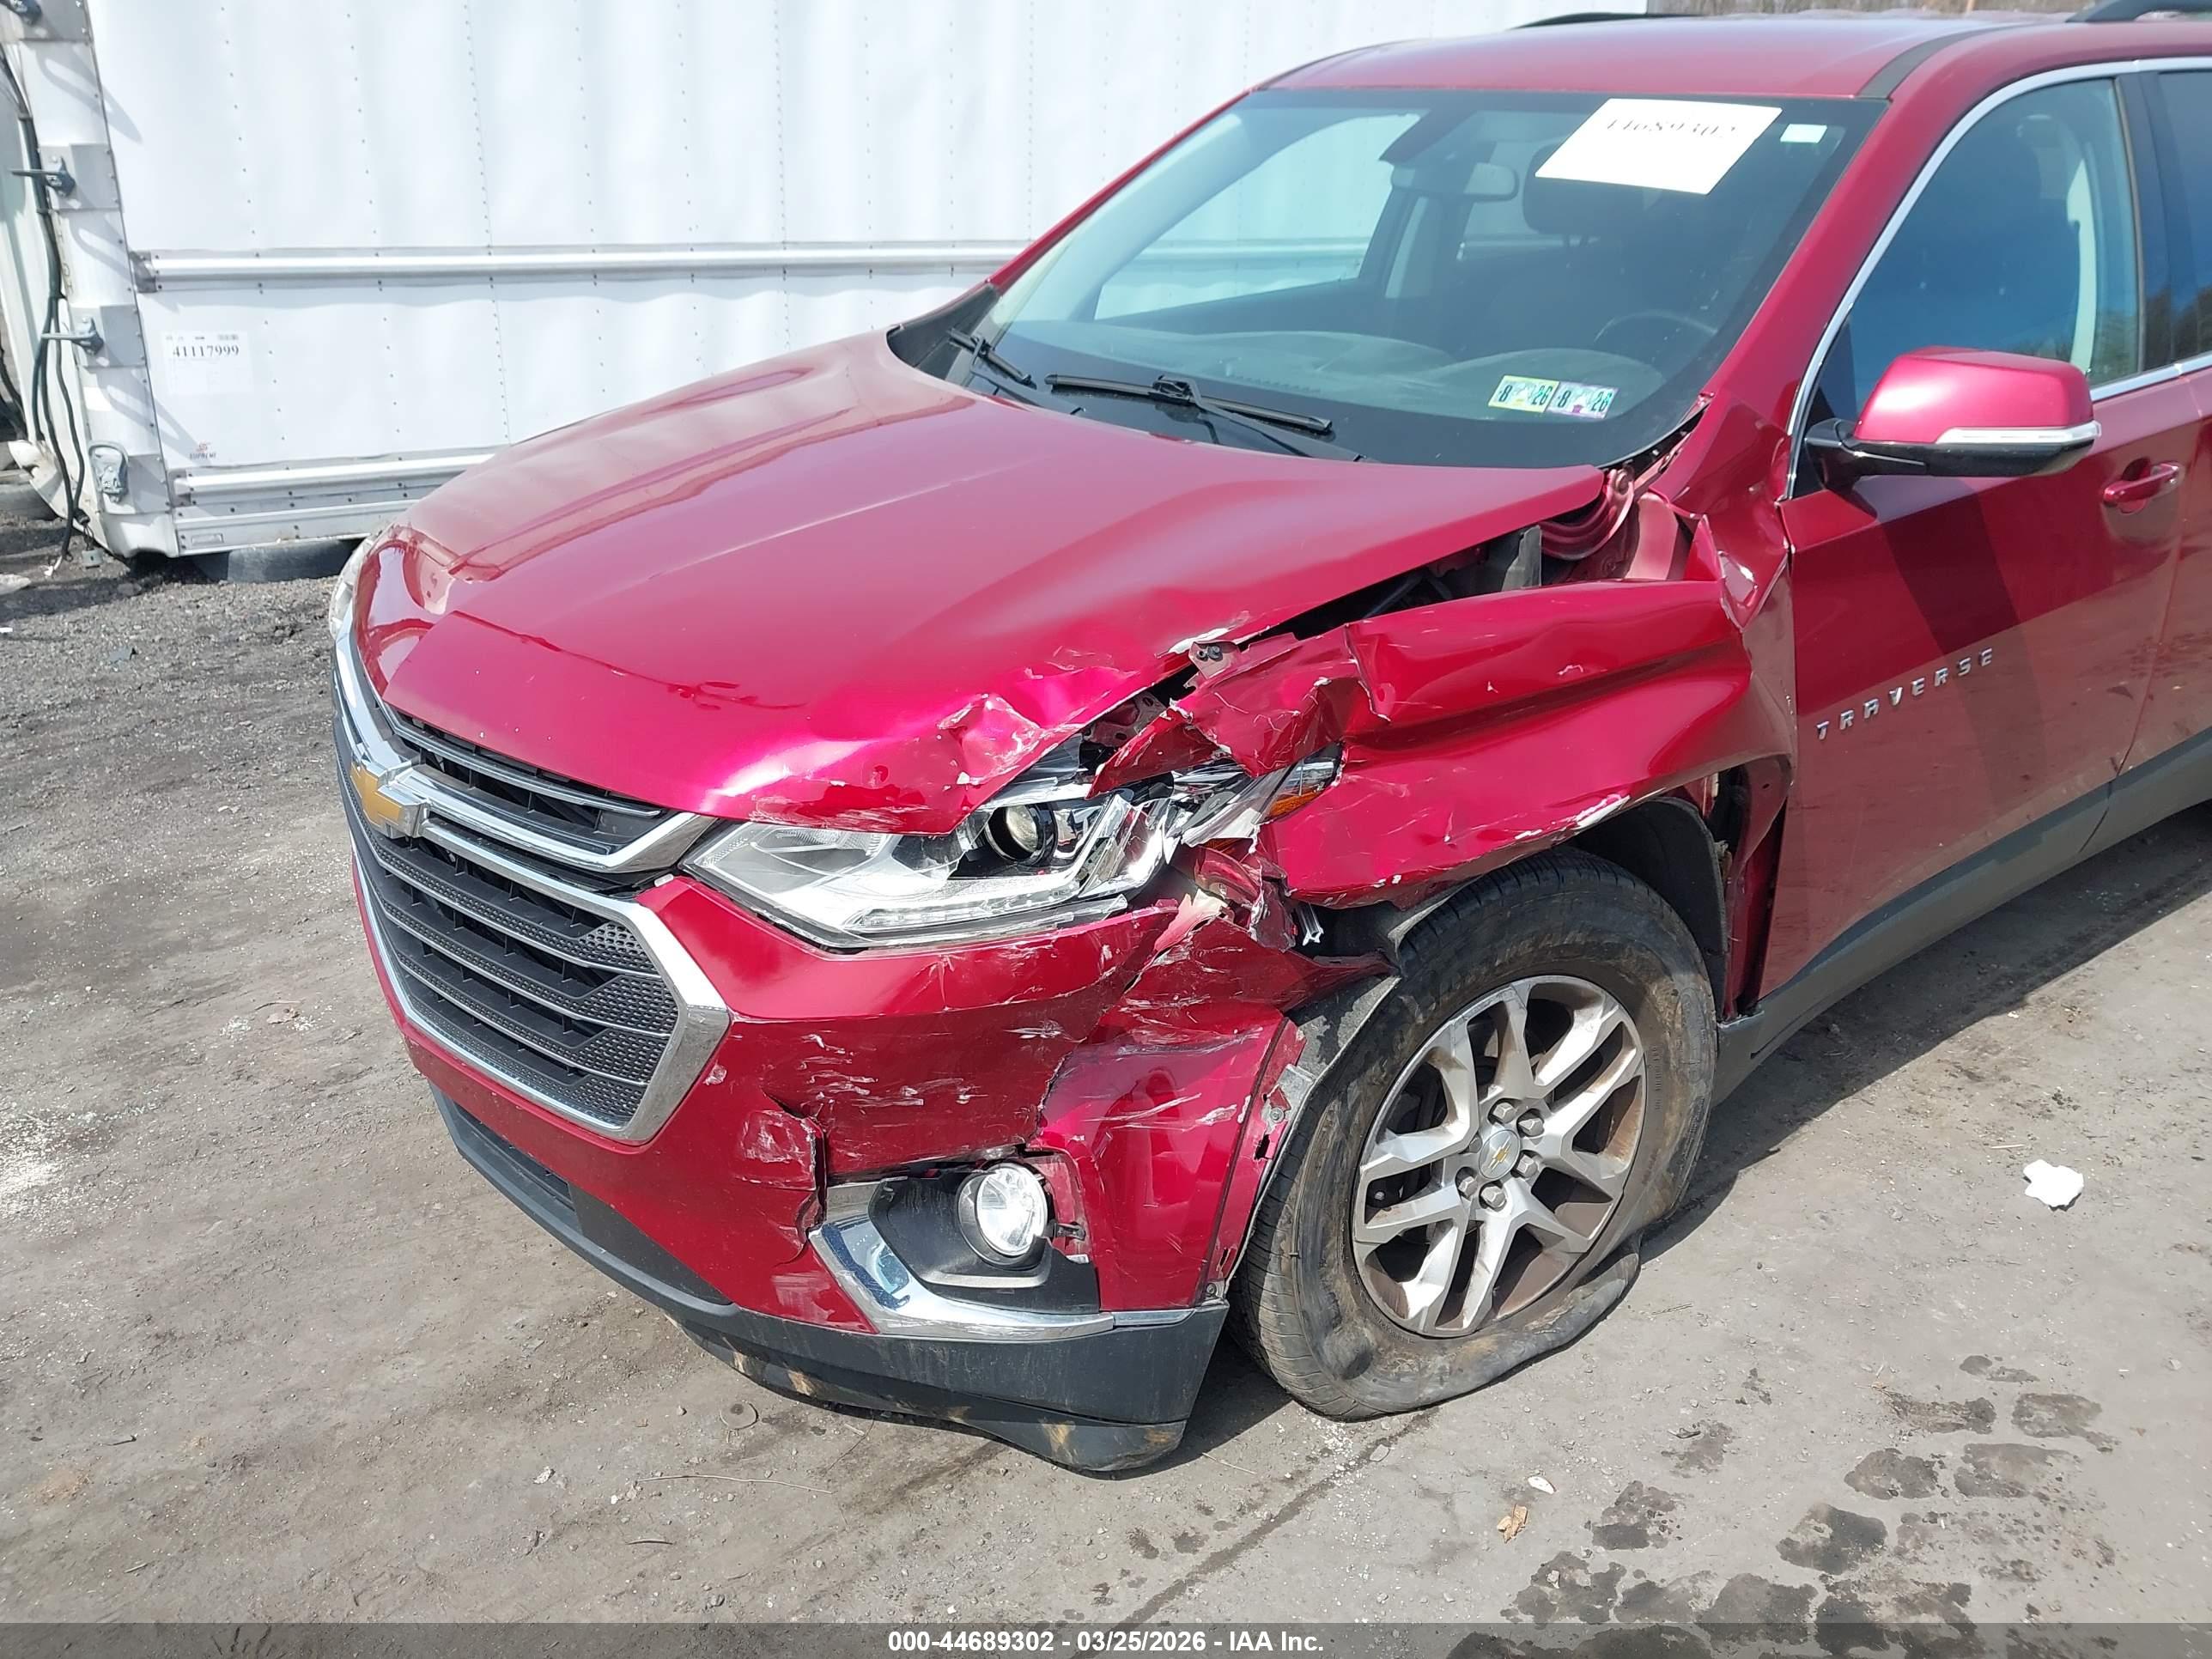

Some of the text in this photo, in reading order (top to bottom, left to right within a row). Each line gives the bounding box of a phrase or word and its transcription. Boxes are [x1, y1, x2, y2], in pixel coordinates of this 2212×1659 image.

[173, 345, 239, 357] 41117999
[1498, 384, 1513, 403] 8
[1558, 391, 1571, 408] 8
[1815, 647, 1993, 741] TRAVERSE
